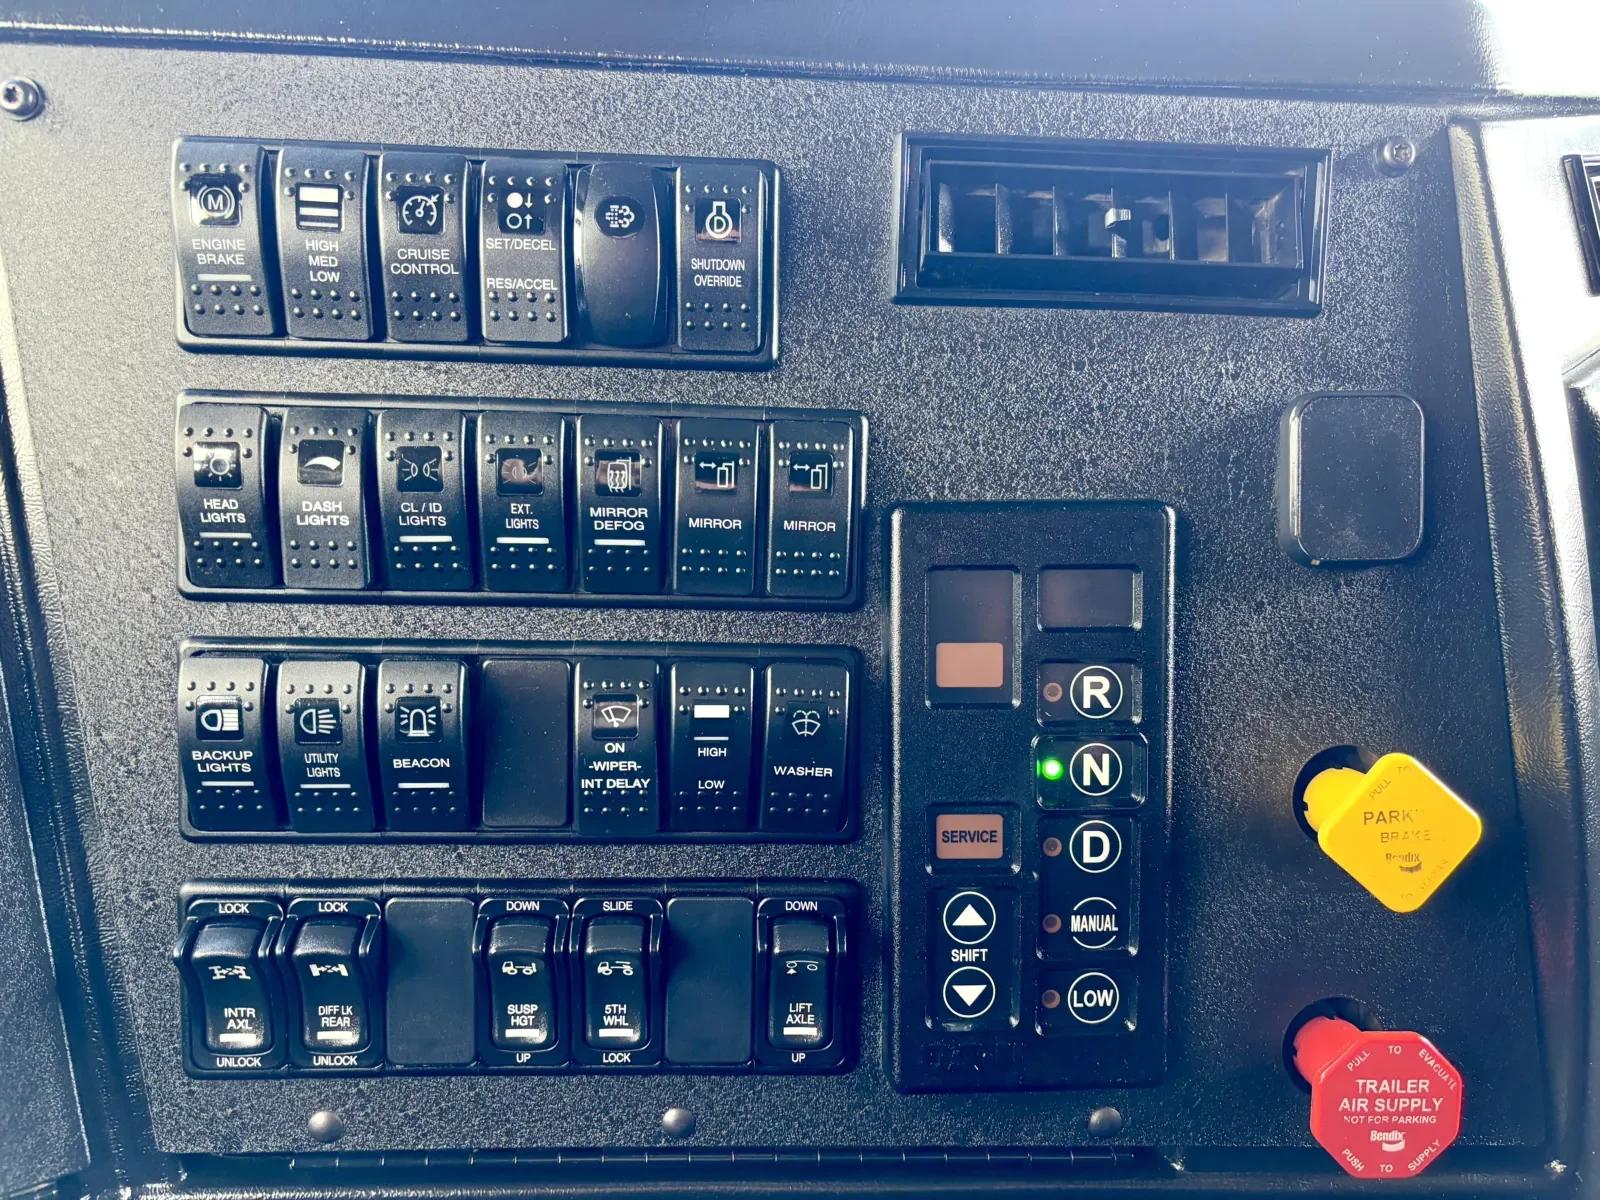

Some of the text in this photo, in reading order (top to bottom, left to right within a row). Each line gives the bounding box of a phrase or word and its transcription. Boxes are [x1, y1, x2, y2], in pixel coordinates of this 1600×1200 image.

[192, 239, 246, 251] ENGINE
[305, 240, 339, 252] HIGH
[486, 238, 556, 251] SET/DECEL
[197, 253, 245, 265] BRAKE
[397, 248, 450, 260] CRUISE
[309, 255, 338, 267] MED
[691, 258, 745, 271] SHUTDOWN
[390, 263, 459, 276] CONTROL
[310, 271, 340, 283] LOW
[694, 275, 742, 287] OVERRIDE
[487, 278, 558, 290] RES/ACCEL
[204, 499, 238, 510] HEAD
[302, 501, 342, 513] DASH
[400, 502, 418, 513] CL
[429, 502, 442, 513] ID
[510, 504, 533, 515] EXT.
[200, 512, 246, 524] LIGHTS
[590, 507, 648, 519] MIRROR
[297, 514, 350, 526] LIGHTS
[399, 515, 447, 527] LIGHTS
[505, 518, 540, 530] LIGHTS
[594, 520, 645, 531] DEFOG
[688, 518, 742, 530] MIRROR
[783, 520, 836, 532] MIRROR
[1082, 675, 1112, 709] R
[605, 743, 625, 754] ON
[698, 747, 727, 758] HIGH
[192, 750, 253, 761] BACKUP
[304, 753, 339, 764] UTILITY
[197, 762, 252, 773] LIGHTS
[393, 758, 450, 769] BEACON
[589, 761, 642, 772] -WIPER-
[1082, 753, 1110, 786] N
[307, 767, 341, 778] LIGHTS
[774, 766, 833, 778] WASHER
[581, 778, 650, 789] INT DELAY
[698, 780, 725, 790] LOW
[941, 830, 998, 844] SERVICE
[1082, 830, 1110, 864] D
[218, 903, 249, 914] LOCK
[318, 902, 348, 913] LOCK
[506, 901, 540, 912] DOWN
[603, 901, 634, 912] SLIDE
[785, 901, 818, 912] DOWN
[1071, 914, 1118, 933] MANUAL
[951, 948, 988, 962] SHIFT
[1073, 989, 1114, 1008] LOW
[224, 1007, 256, 1019] INTR
[318, 1005, 353, 1016] DIFF LK
[507, 1004, 538, 1015] SUSP
[604, 1004, 627, 1015] 5TH
[789, 1003, 813, 1014] LIFT
[226, 1018, 252, 1030] AXL
[321, 1016, 351, 1027] REAR
[511, 1015, 535, 1027] HGT
[603, 1015, 629, 1026] WHL
[786, 1014, 815, 1025] AXLE
[216, 1056, 262, 1068] UNLOCK
[313, 1055, 358, 1067] UNLOCK
[516, 1053, 531, 1064] UP
[602, 1053, 631, 1064] LOCK
[791, 1053, 806, 1064] UP
[1347, 1049, 1371, 1072] PULL
[1388, 1046, 1402, 1055] TO
[1356, 1079, 1430, 1094] TRAILER
[1338, 1097, 1444, 1112] AIR SUPPLY
[1343, 1115, 1437, 1125] NOT FOR PARKING
[1370, 1130, 1404, 1142] Bendix
[1342, 1139, 1442, 1173] PUSH TO SUPPLY
